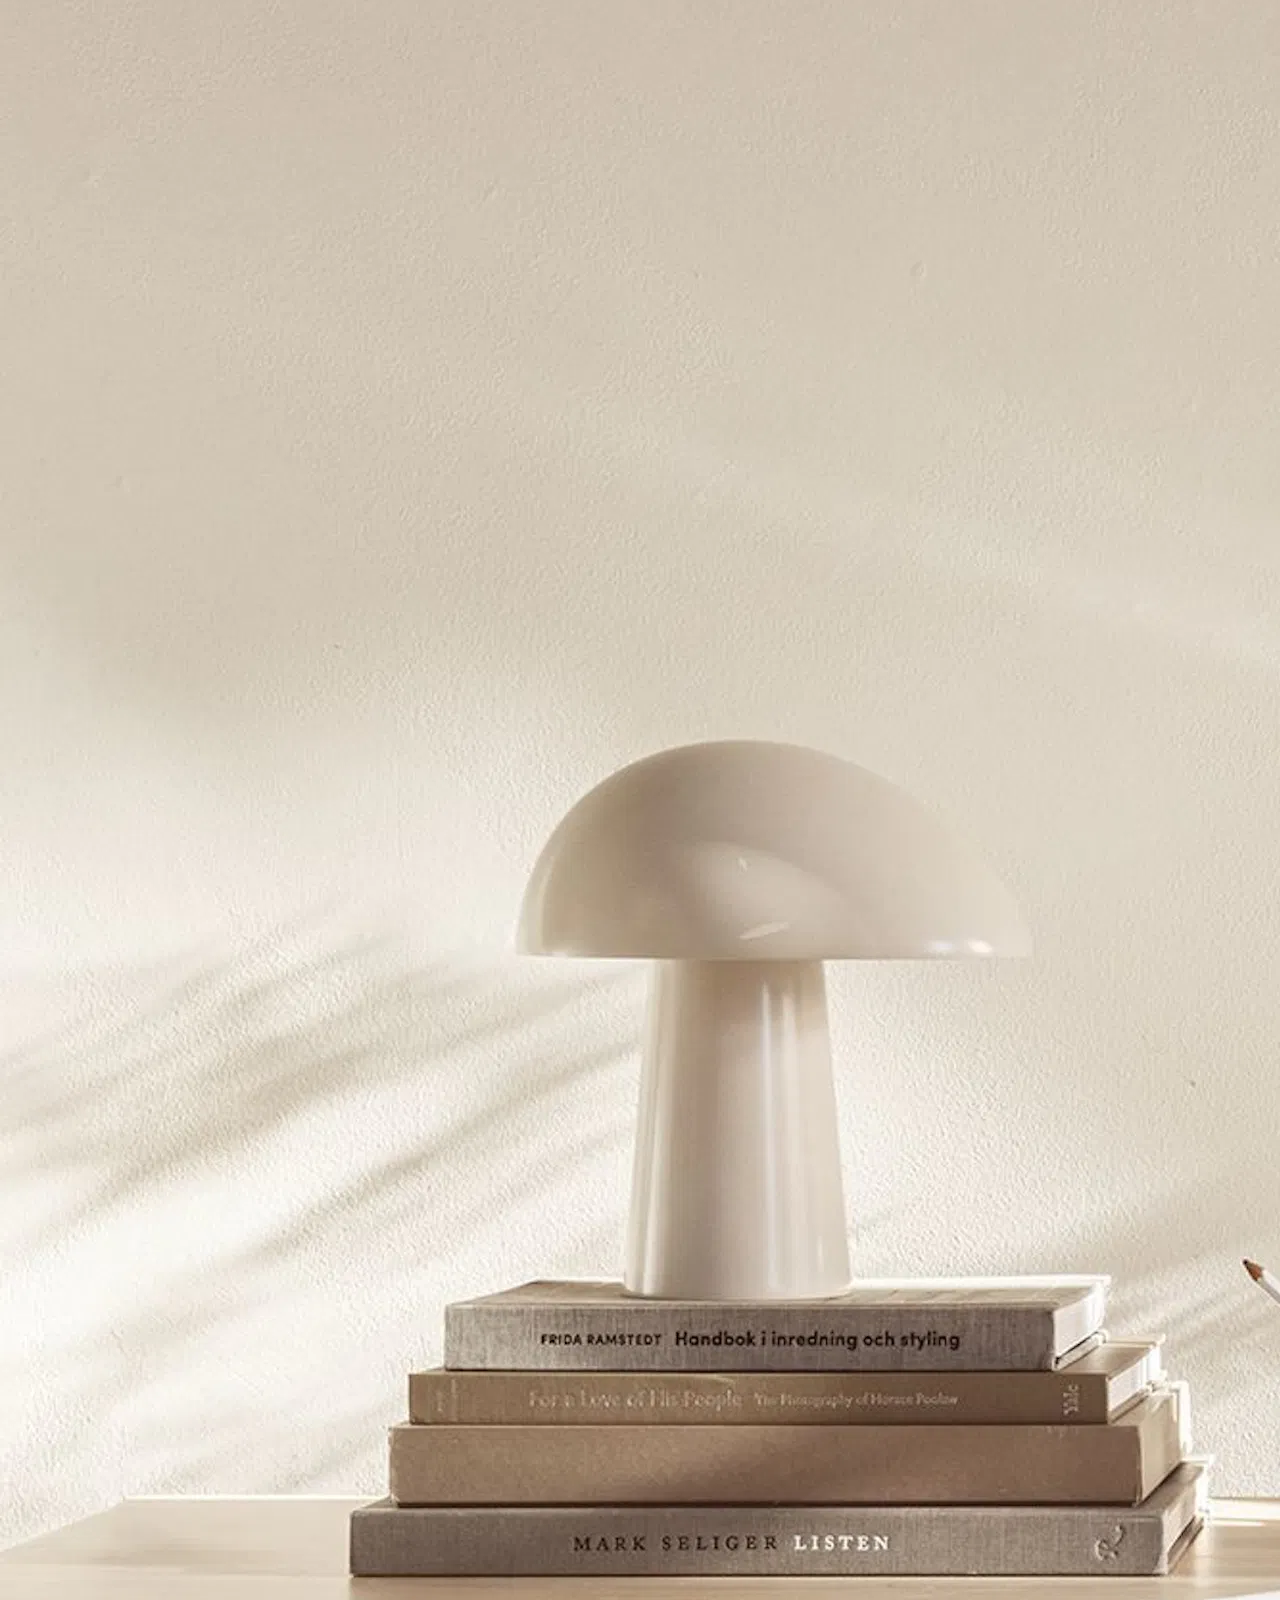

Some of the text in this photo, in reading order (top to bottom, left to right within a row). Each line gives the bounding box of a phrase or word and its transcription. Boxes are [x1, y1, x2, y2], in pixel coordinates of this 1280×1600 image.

[540, 1333, 583, 1346] FRIDA
[587, 1333, 663, 1346] RAMSTEDT
[675, 1330, 756, 1347] Handbok
[772, 1330, 858, 1352] inredning
[863, 1330, 896, 1347] och
[900, 1330, 961, 1352] styling
[573, 1535, 890, 1551] MARK SELIGER LISTEN
